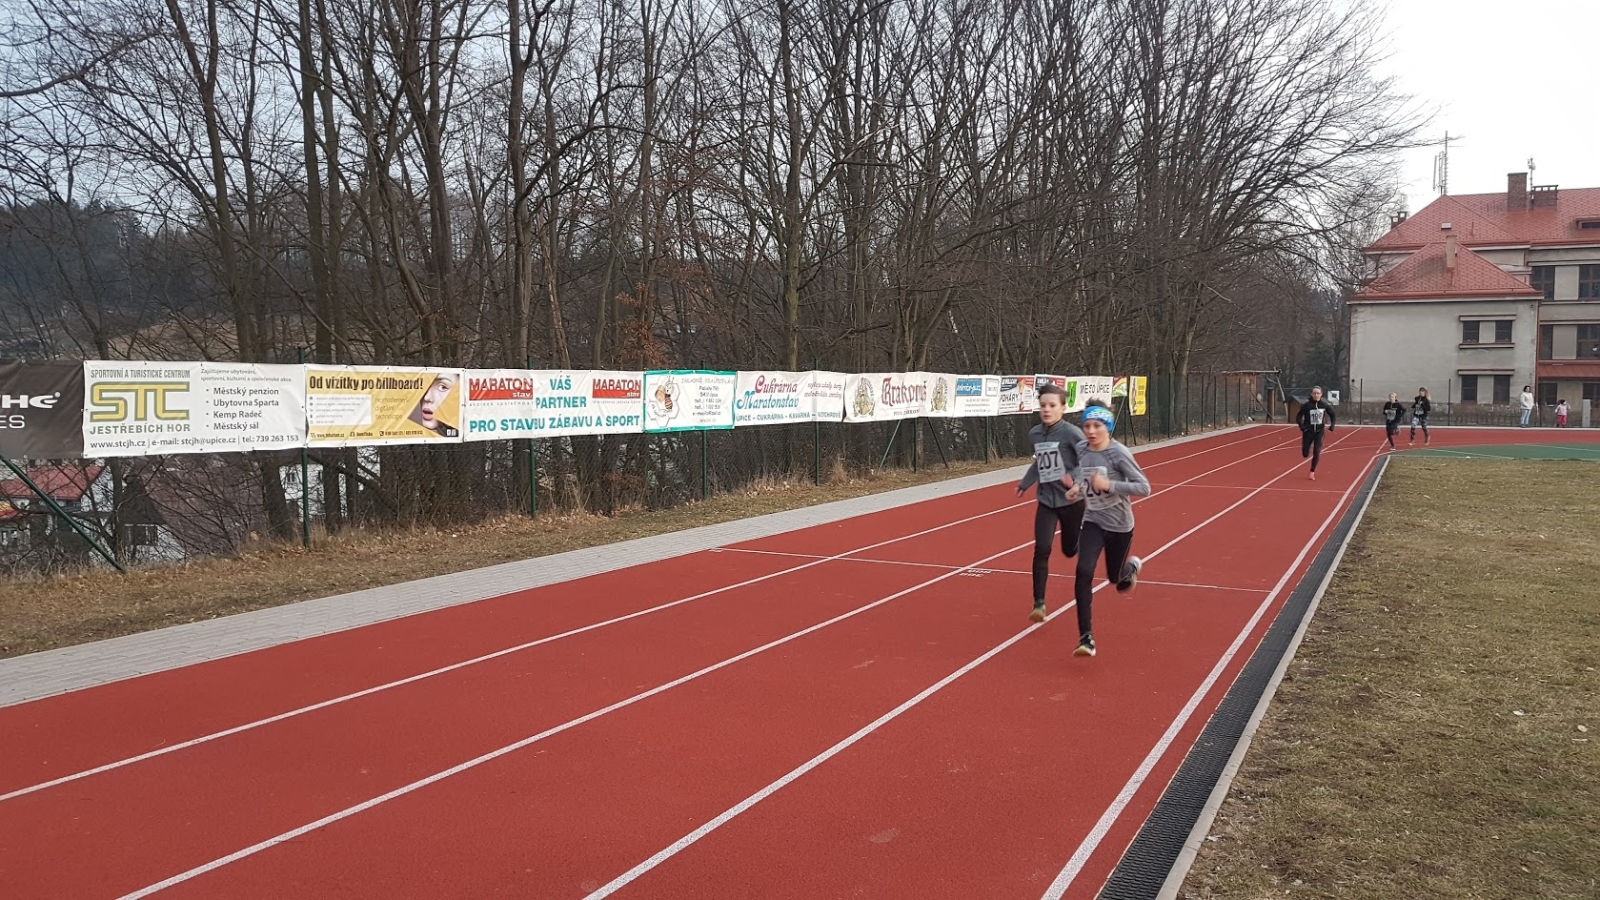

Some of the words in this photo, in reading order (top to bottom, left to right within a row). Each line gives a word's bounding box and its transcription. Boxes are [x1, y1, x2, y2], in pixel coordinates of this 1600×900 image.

[91, 368, 124, 379] SPORTOVNÍ
[125, 369, 130, 379] A
[131, 368, 163, 379] TURISTICKÉ
[164, 369, 191, 378] CENTRUM
[309, 375, 323, 389] Od
[325, 376, 359, 391] vizitky
[361, 377, 375, 391] po
[376, 377, 424, 390] billboard!
[469, 378, 533, 391] MARATON
[550, 375, 572, 391] VÁŠ
[593, 378, 642, 391] MARATON
[755, 375, 798, 394] Cukrárna
[213, 387, 247, 396] Městský
[249, 387, 279, 396] penzion
[90, 381, 190, 422] STC
[213, 398, 253, 408] Ubytovna
[254, 398, 279, 407] Sparta
[536, 397, 587, 409] PARTNER
[213, 410, 237, 419] Kemp
[239, 410, 262, 419] Radeč
[90, 423, 163, 435] JESTŘEBÍCH
[167, 424, 191, 432] HOR
[213, 422, 248, 431] Městský
[249, 422, 259, 430] sál
[469, 419, 497, 433] PRO
[549, 414, 592, 429] ZÁBAVU
[595, 416, 603, 427] A
[606, 415, 640, 427] SPORT
[90, 440, 146, 449] www.stcjh.cz
[152, 438, 180, 446] e-mail:
[256, 435, 270, 443] 739
[1037, 451, 1058, 470] 207
